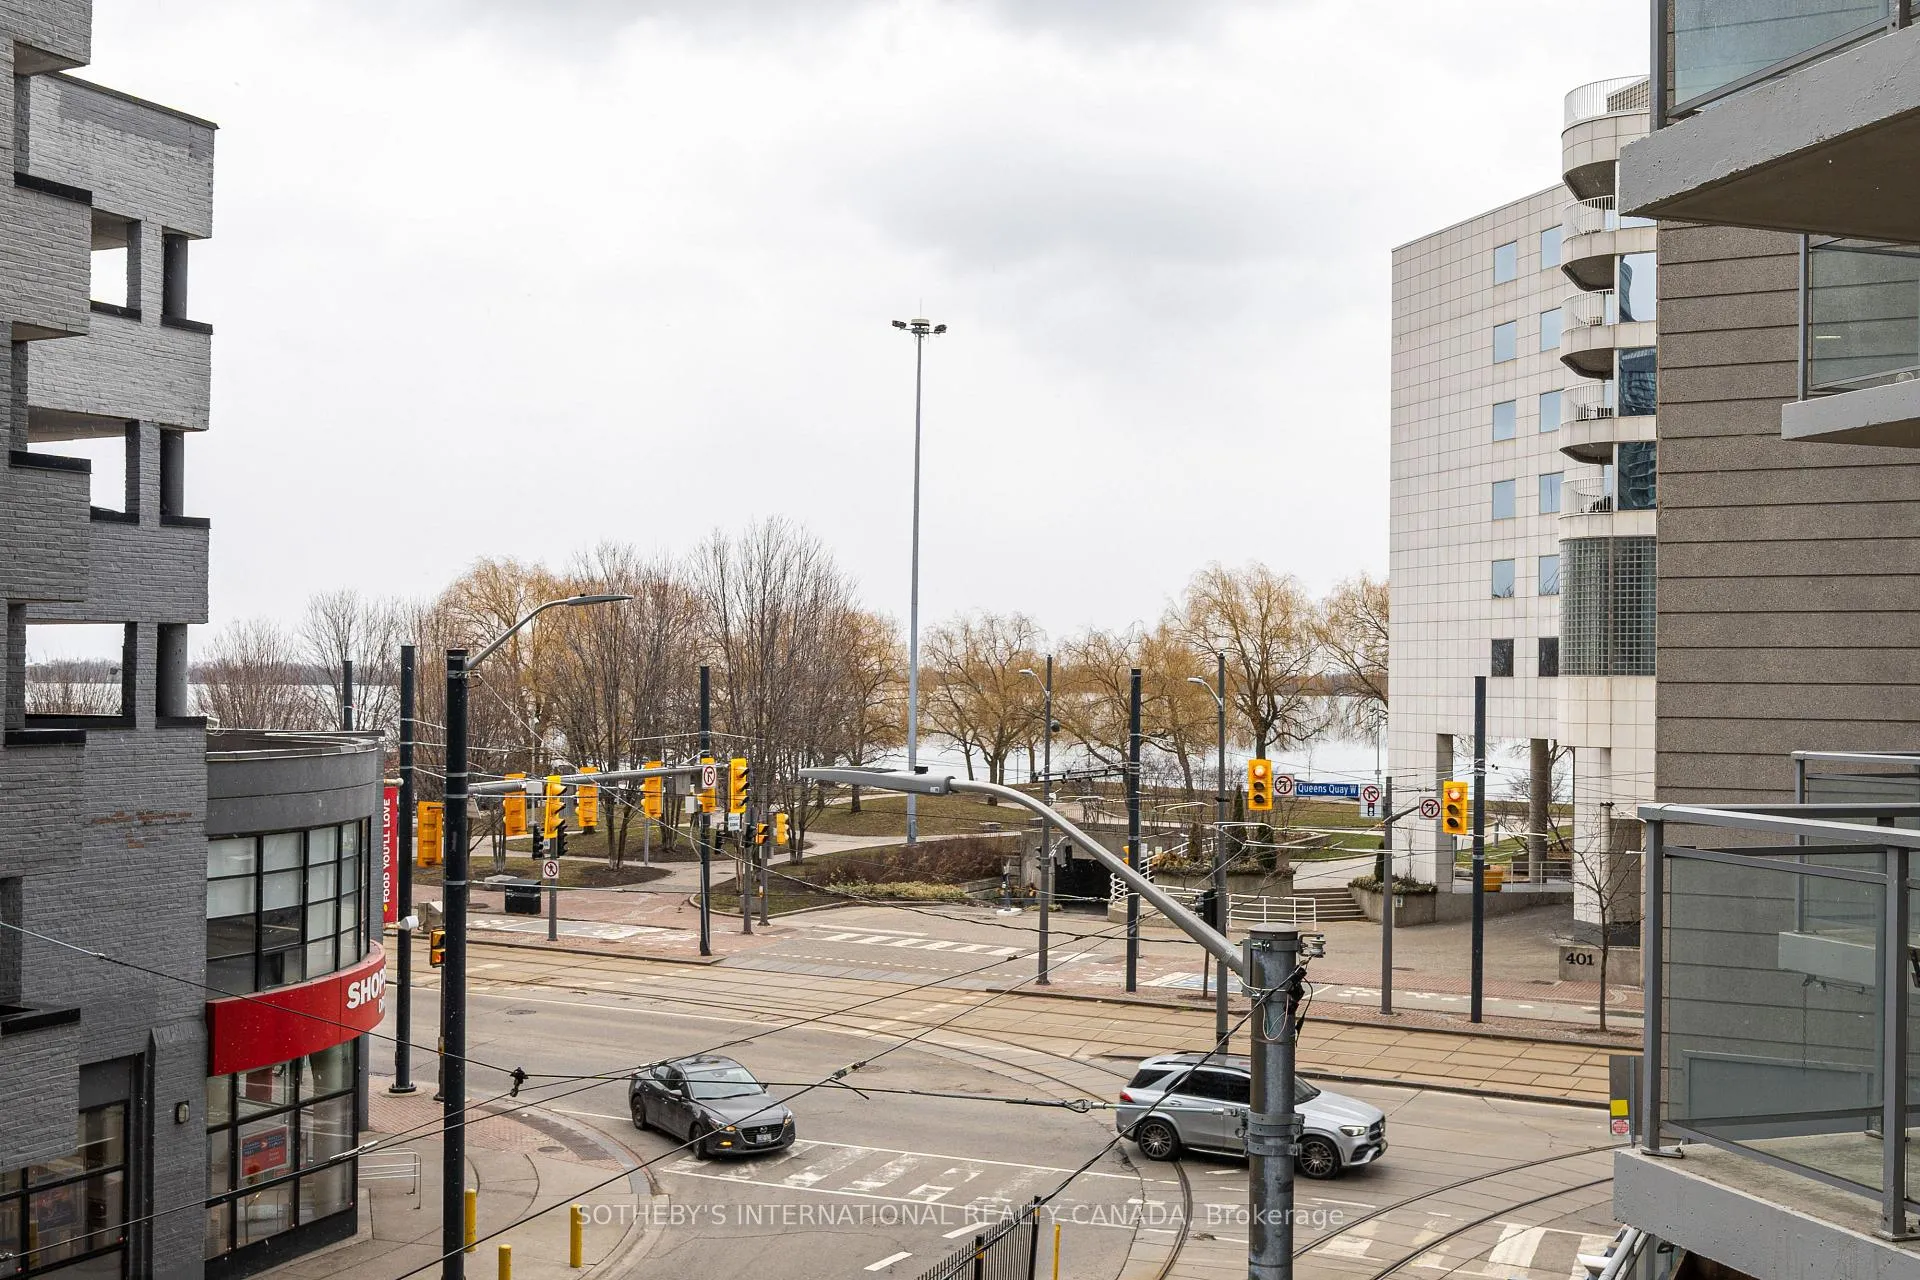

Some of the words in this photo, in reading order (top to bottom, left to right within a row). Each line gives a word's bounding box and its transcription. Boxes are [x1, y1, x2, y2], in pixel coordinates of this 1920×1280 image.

[1297, 783, 1327, 794] Queens
[1328, 784, 1348, 796] Quay
[1349, 784, 1357, 794] W
[383, 798, 391, 828] LOVE
[383, 830, 391, 870] YOU'LL
[383, 872, 391, 903] FOOD
[1564, 952, 1595, 966] 401
